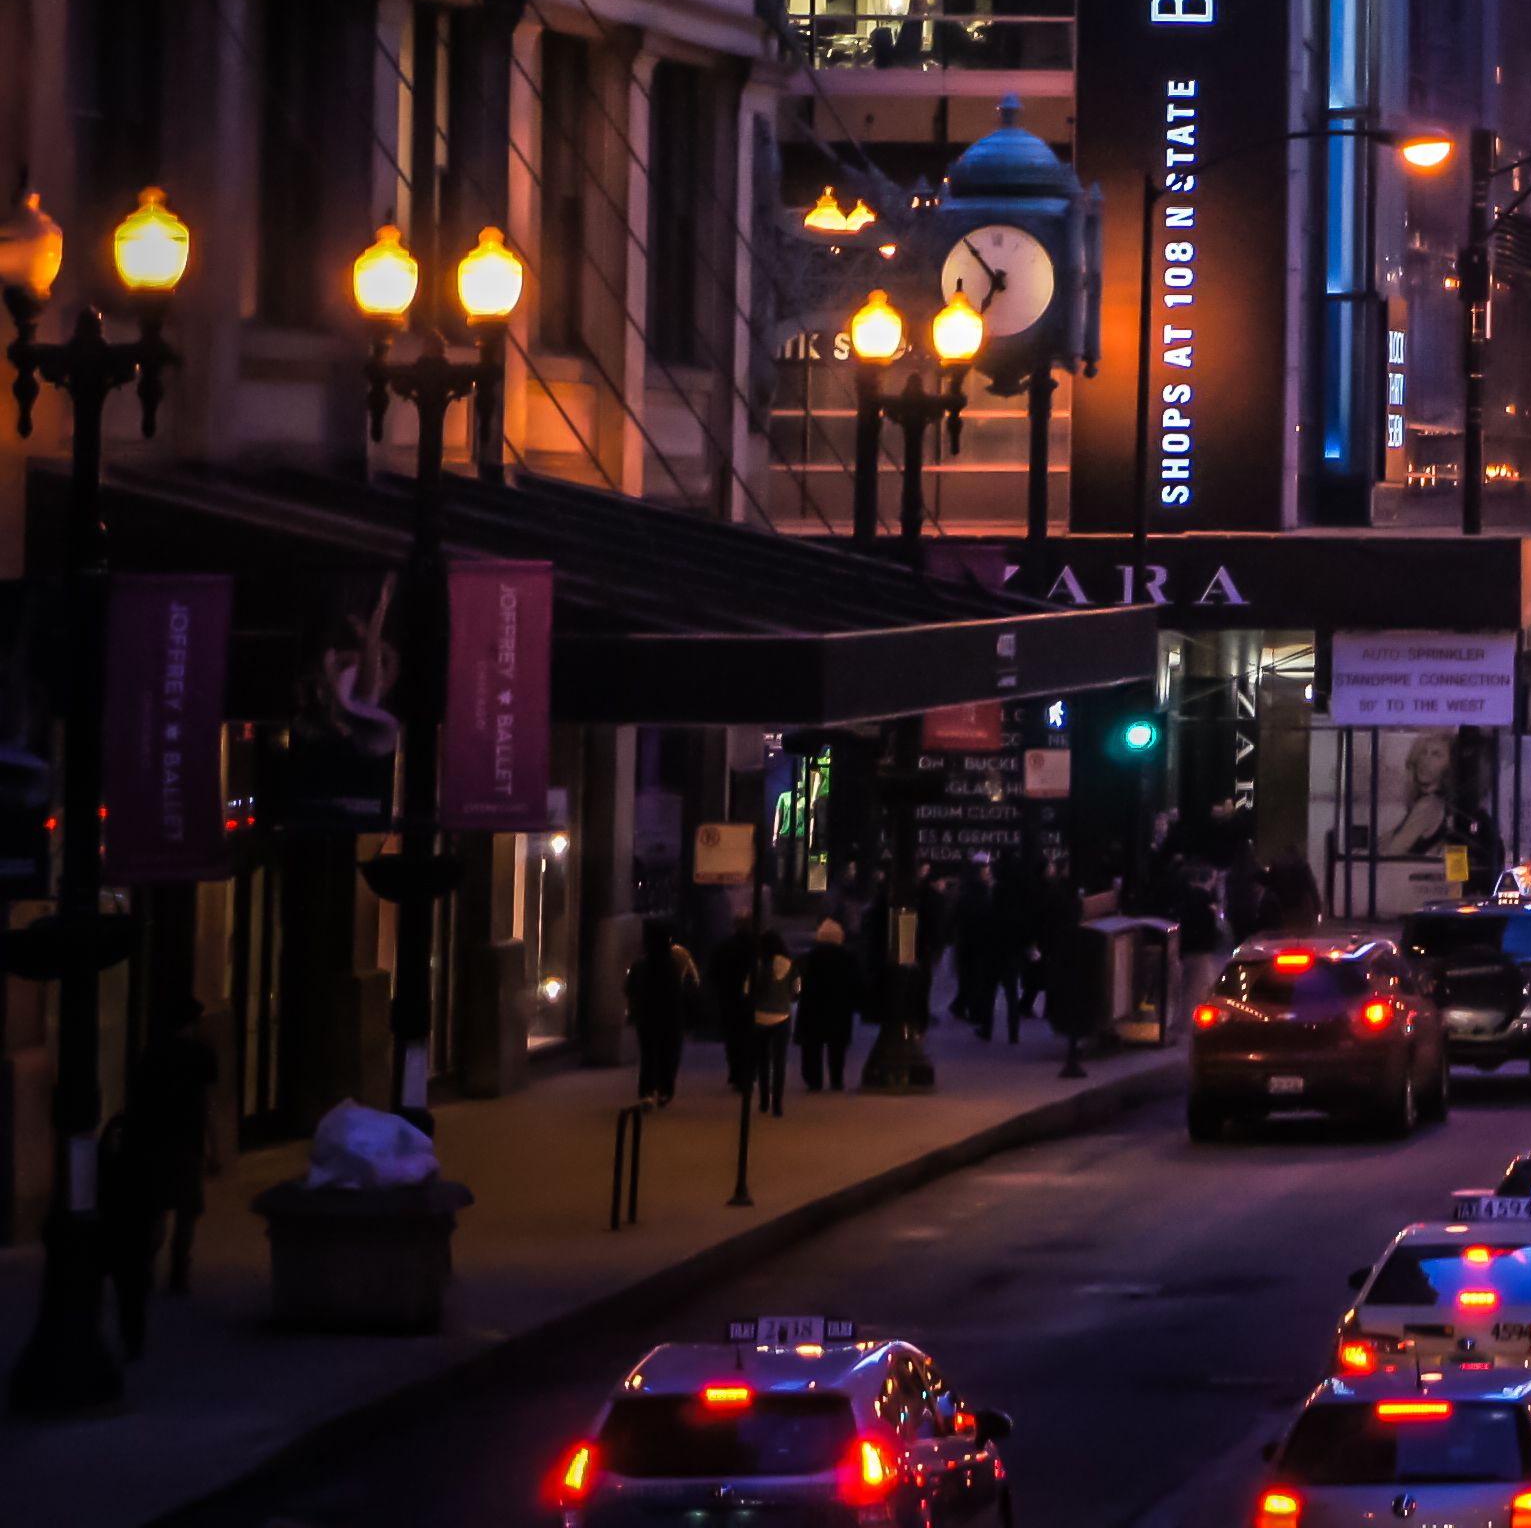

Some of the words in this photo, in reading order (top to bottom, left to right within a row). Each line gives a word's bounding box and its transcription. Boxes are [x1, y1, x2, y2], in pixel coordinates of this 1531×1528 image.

[1166, 79, 1197, 193] STATE
[1165, 207, 1196, 228] N
[1164, 240, 1196, 309] 108
[1163, 323, 1195, 369] AT
[1161, 384, 1193, 506] SHOPS
[1334, 673, 1412, 687] STANDPIPE
[1418, 673, 1511, 687] CONNECTION
[1361, 647, 1400, 661] AUTO
[1407, 647, 1485, 661] SPRINKLER
[1386, 698, 1405, 712] TO
[1413, 698, 1439, 712] THE
[1446, 698, 1486, 712] WEST
[494, 711, 514, 797] BALLET
[161, 750, 186, 843] BALLET
